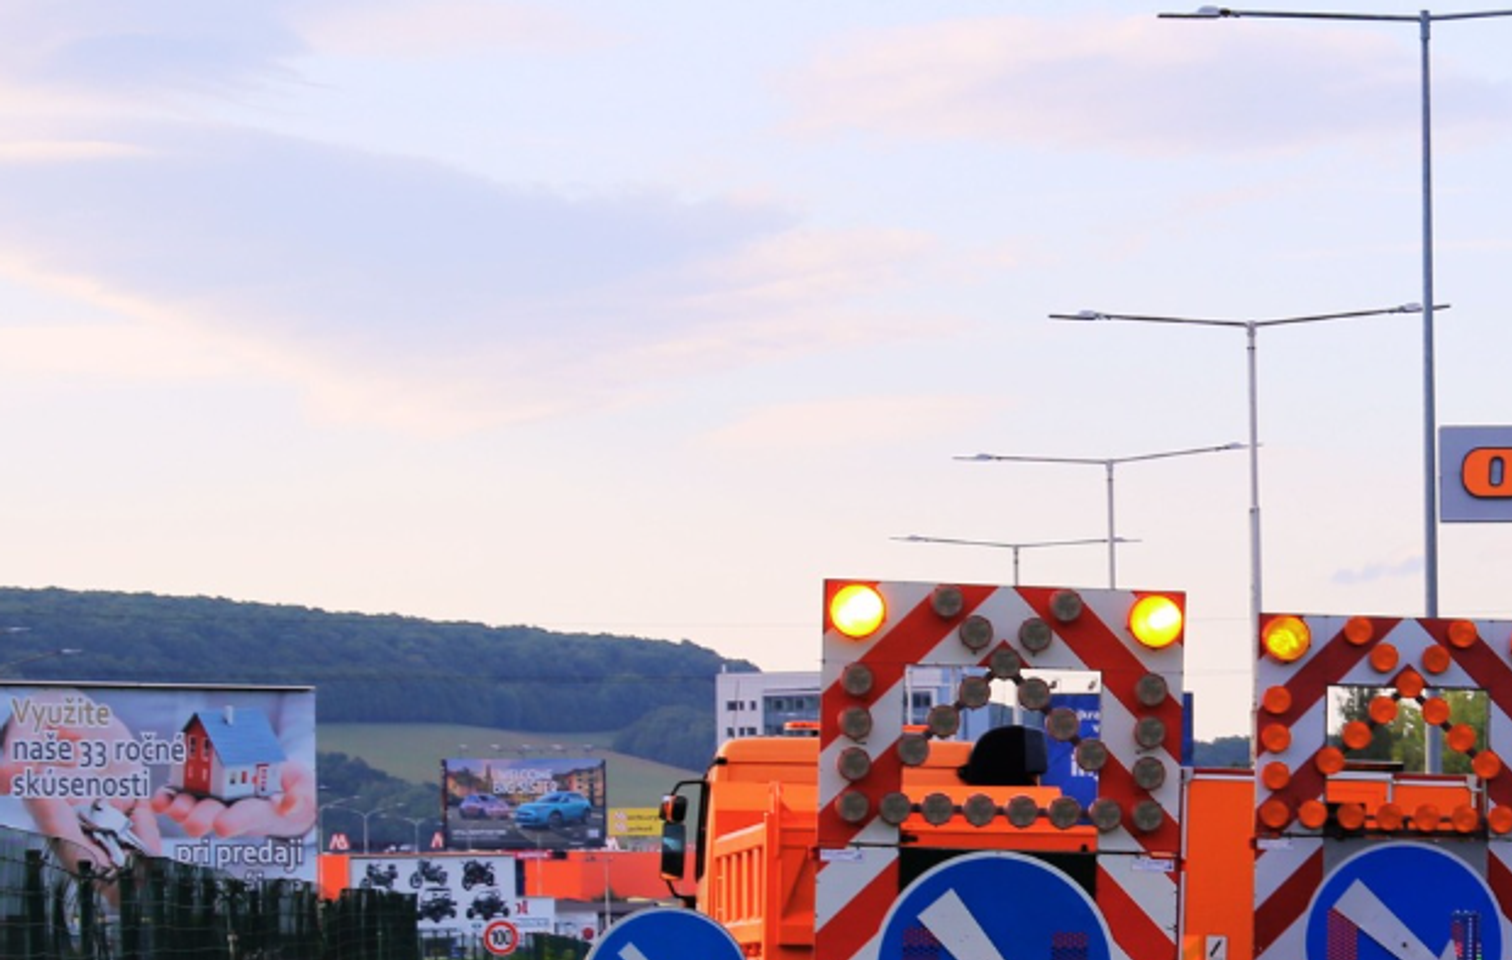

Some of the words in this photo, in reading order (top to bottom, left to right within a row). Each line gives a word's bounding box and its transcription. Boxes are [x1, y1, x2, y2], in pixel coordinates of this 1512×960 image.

[11, 698, 112, 729] Využite
[12, 735, 72, 761] naše
[79, 741, 107, 768] 33
[115, 733, 186, 762] ročné
[12, 769, 150, 797] skúsenosti
[177, 840, 209, 865] pri
[216, 840, 304, 870] predaji
[491, 929, 511, 946] 100
